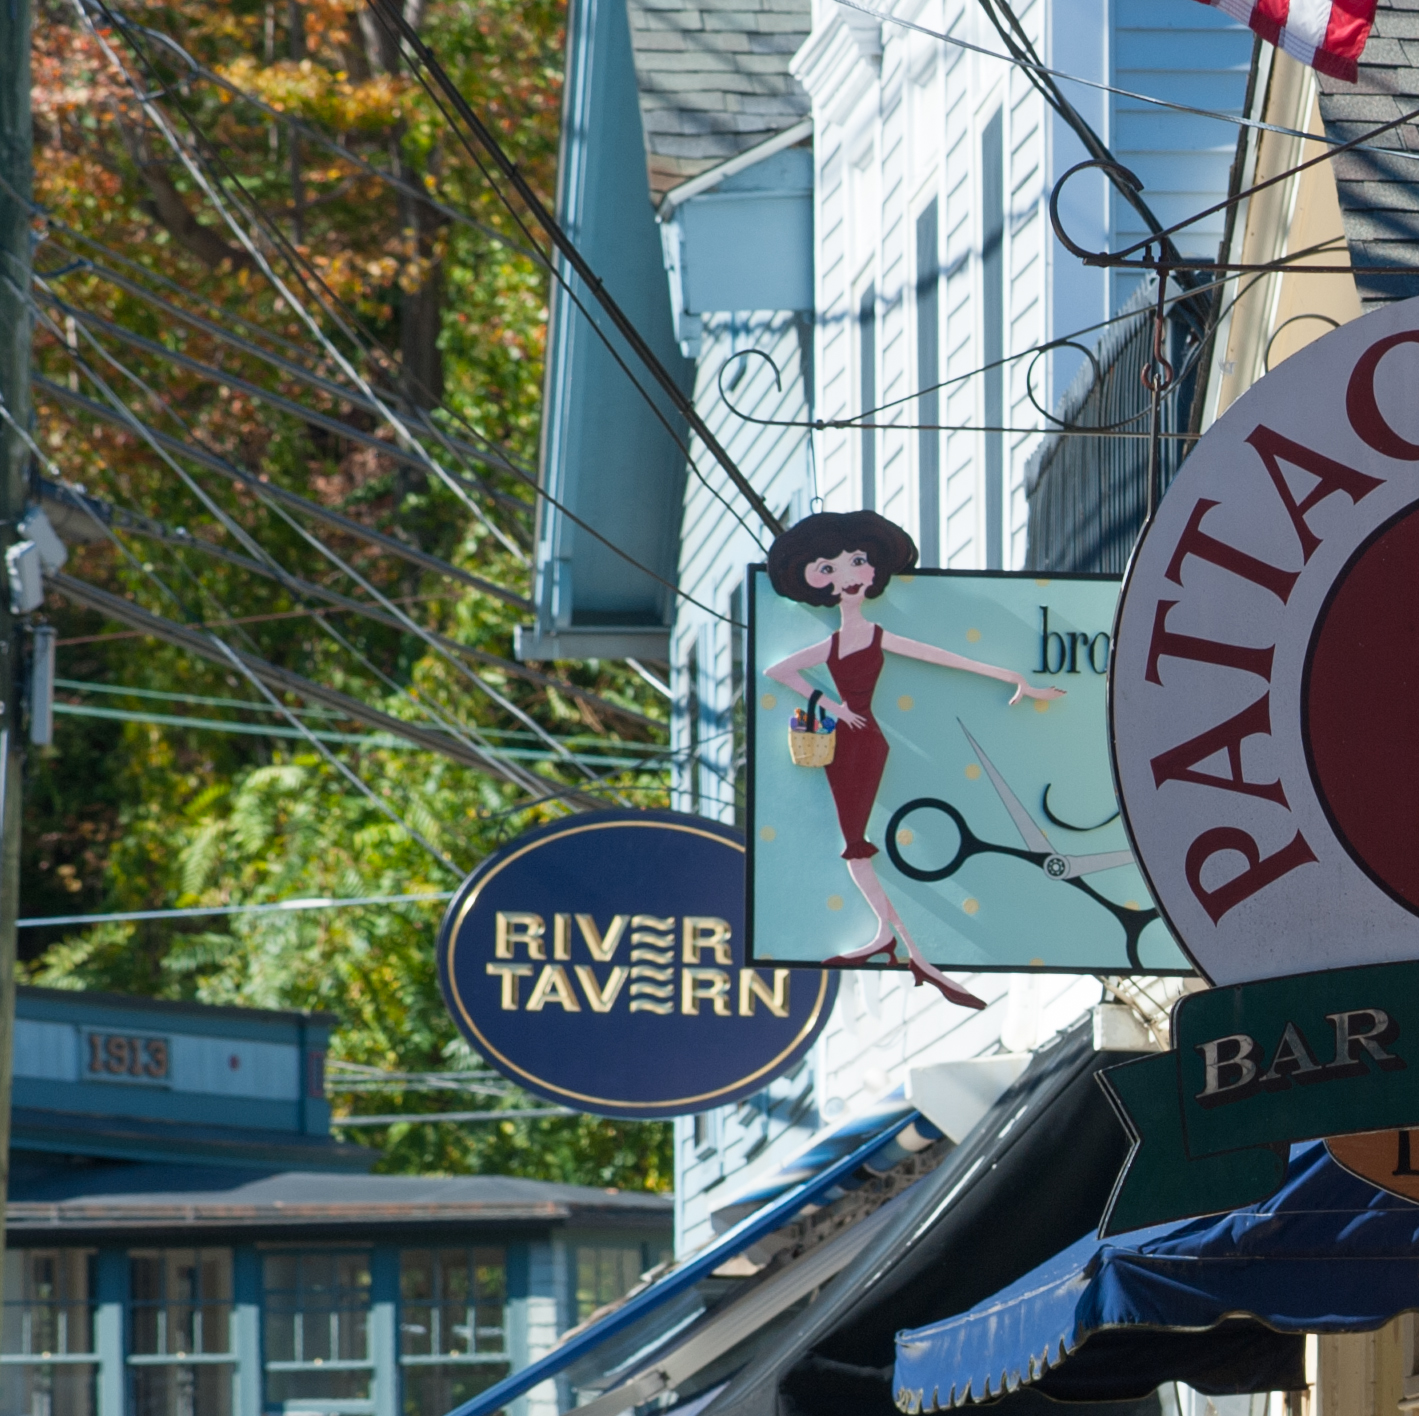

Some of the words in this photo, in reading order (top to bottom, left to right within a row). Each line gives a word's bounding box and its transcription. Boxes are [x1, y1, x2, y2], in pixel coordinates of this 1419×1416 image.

[495, 909, 734, 966] RIVER
[485, 962, 791, 1019] TAVERN
[88, 1035, 170, 1078] 1913
[1194, 1007, 1398, 1100] BAR
